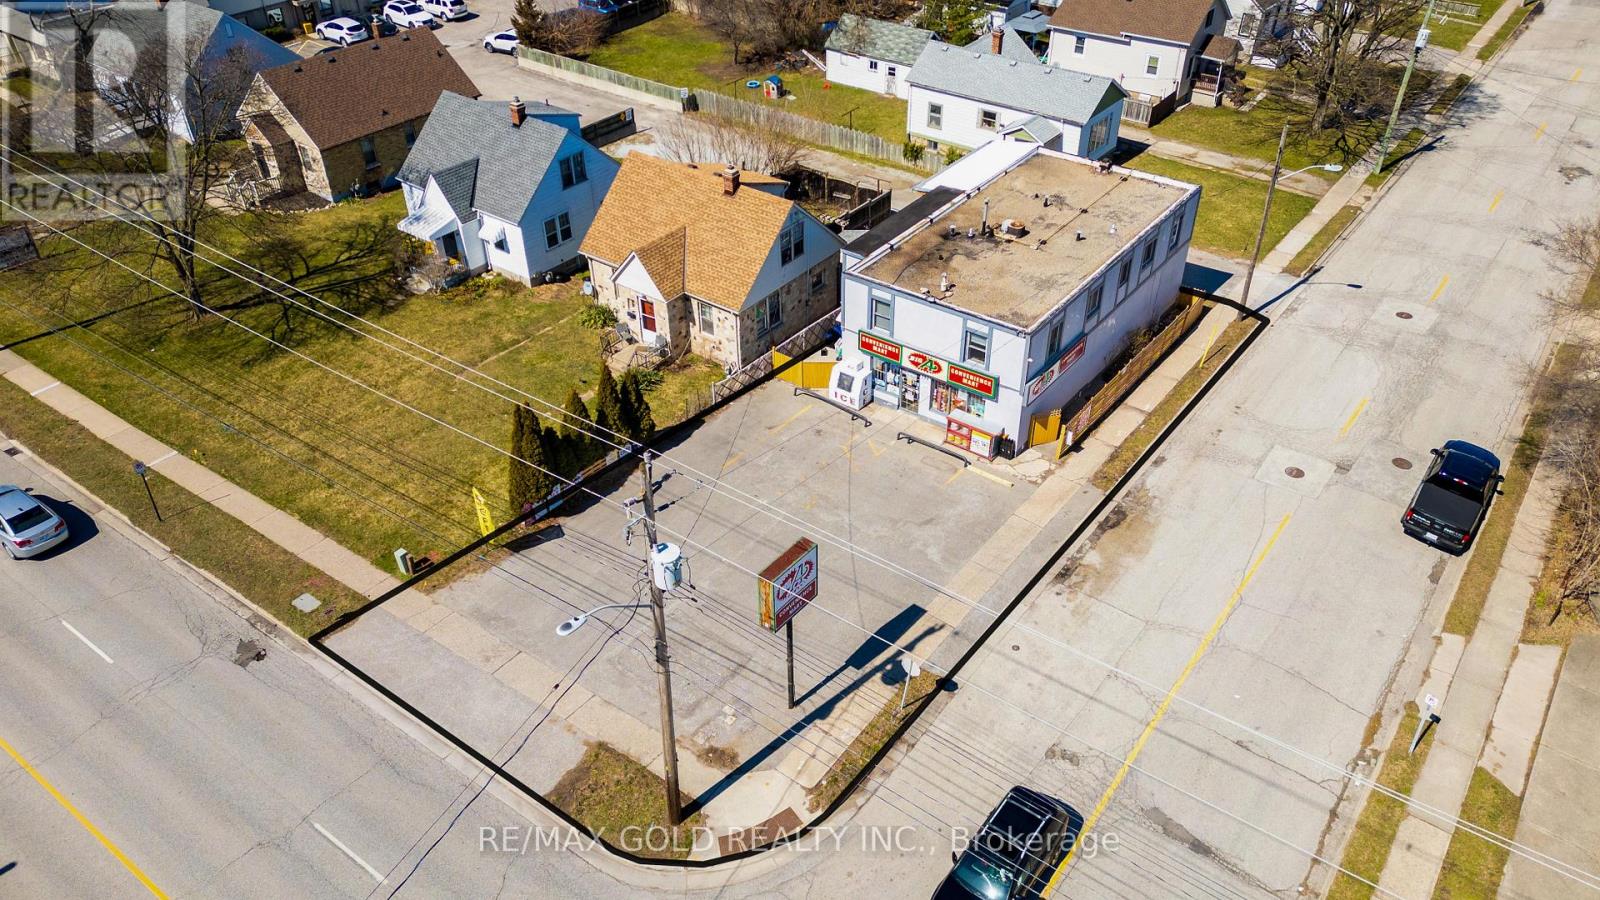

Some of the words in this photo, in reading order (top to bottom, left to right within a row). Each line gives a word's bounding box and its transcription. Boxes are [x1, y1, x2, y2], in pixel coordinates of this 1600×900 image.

[872, 345, 888, 355] MART
[951, 368, 992, 387] CONVENIENCE
[962, 378, 979, 388] MART
[834, 391, 856, 405] ICE
